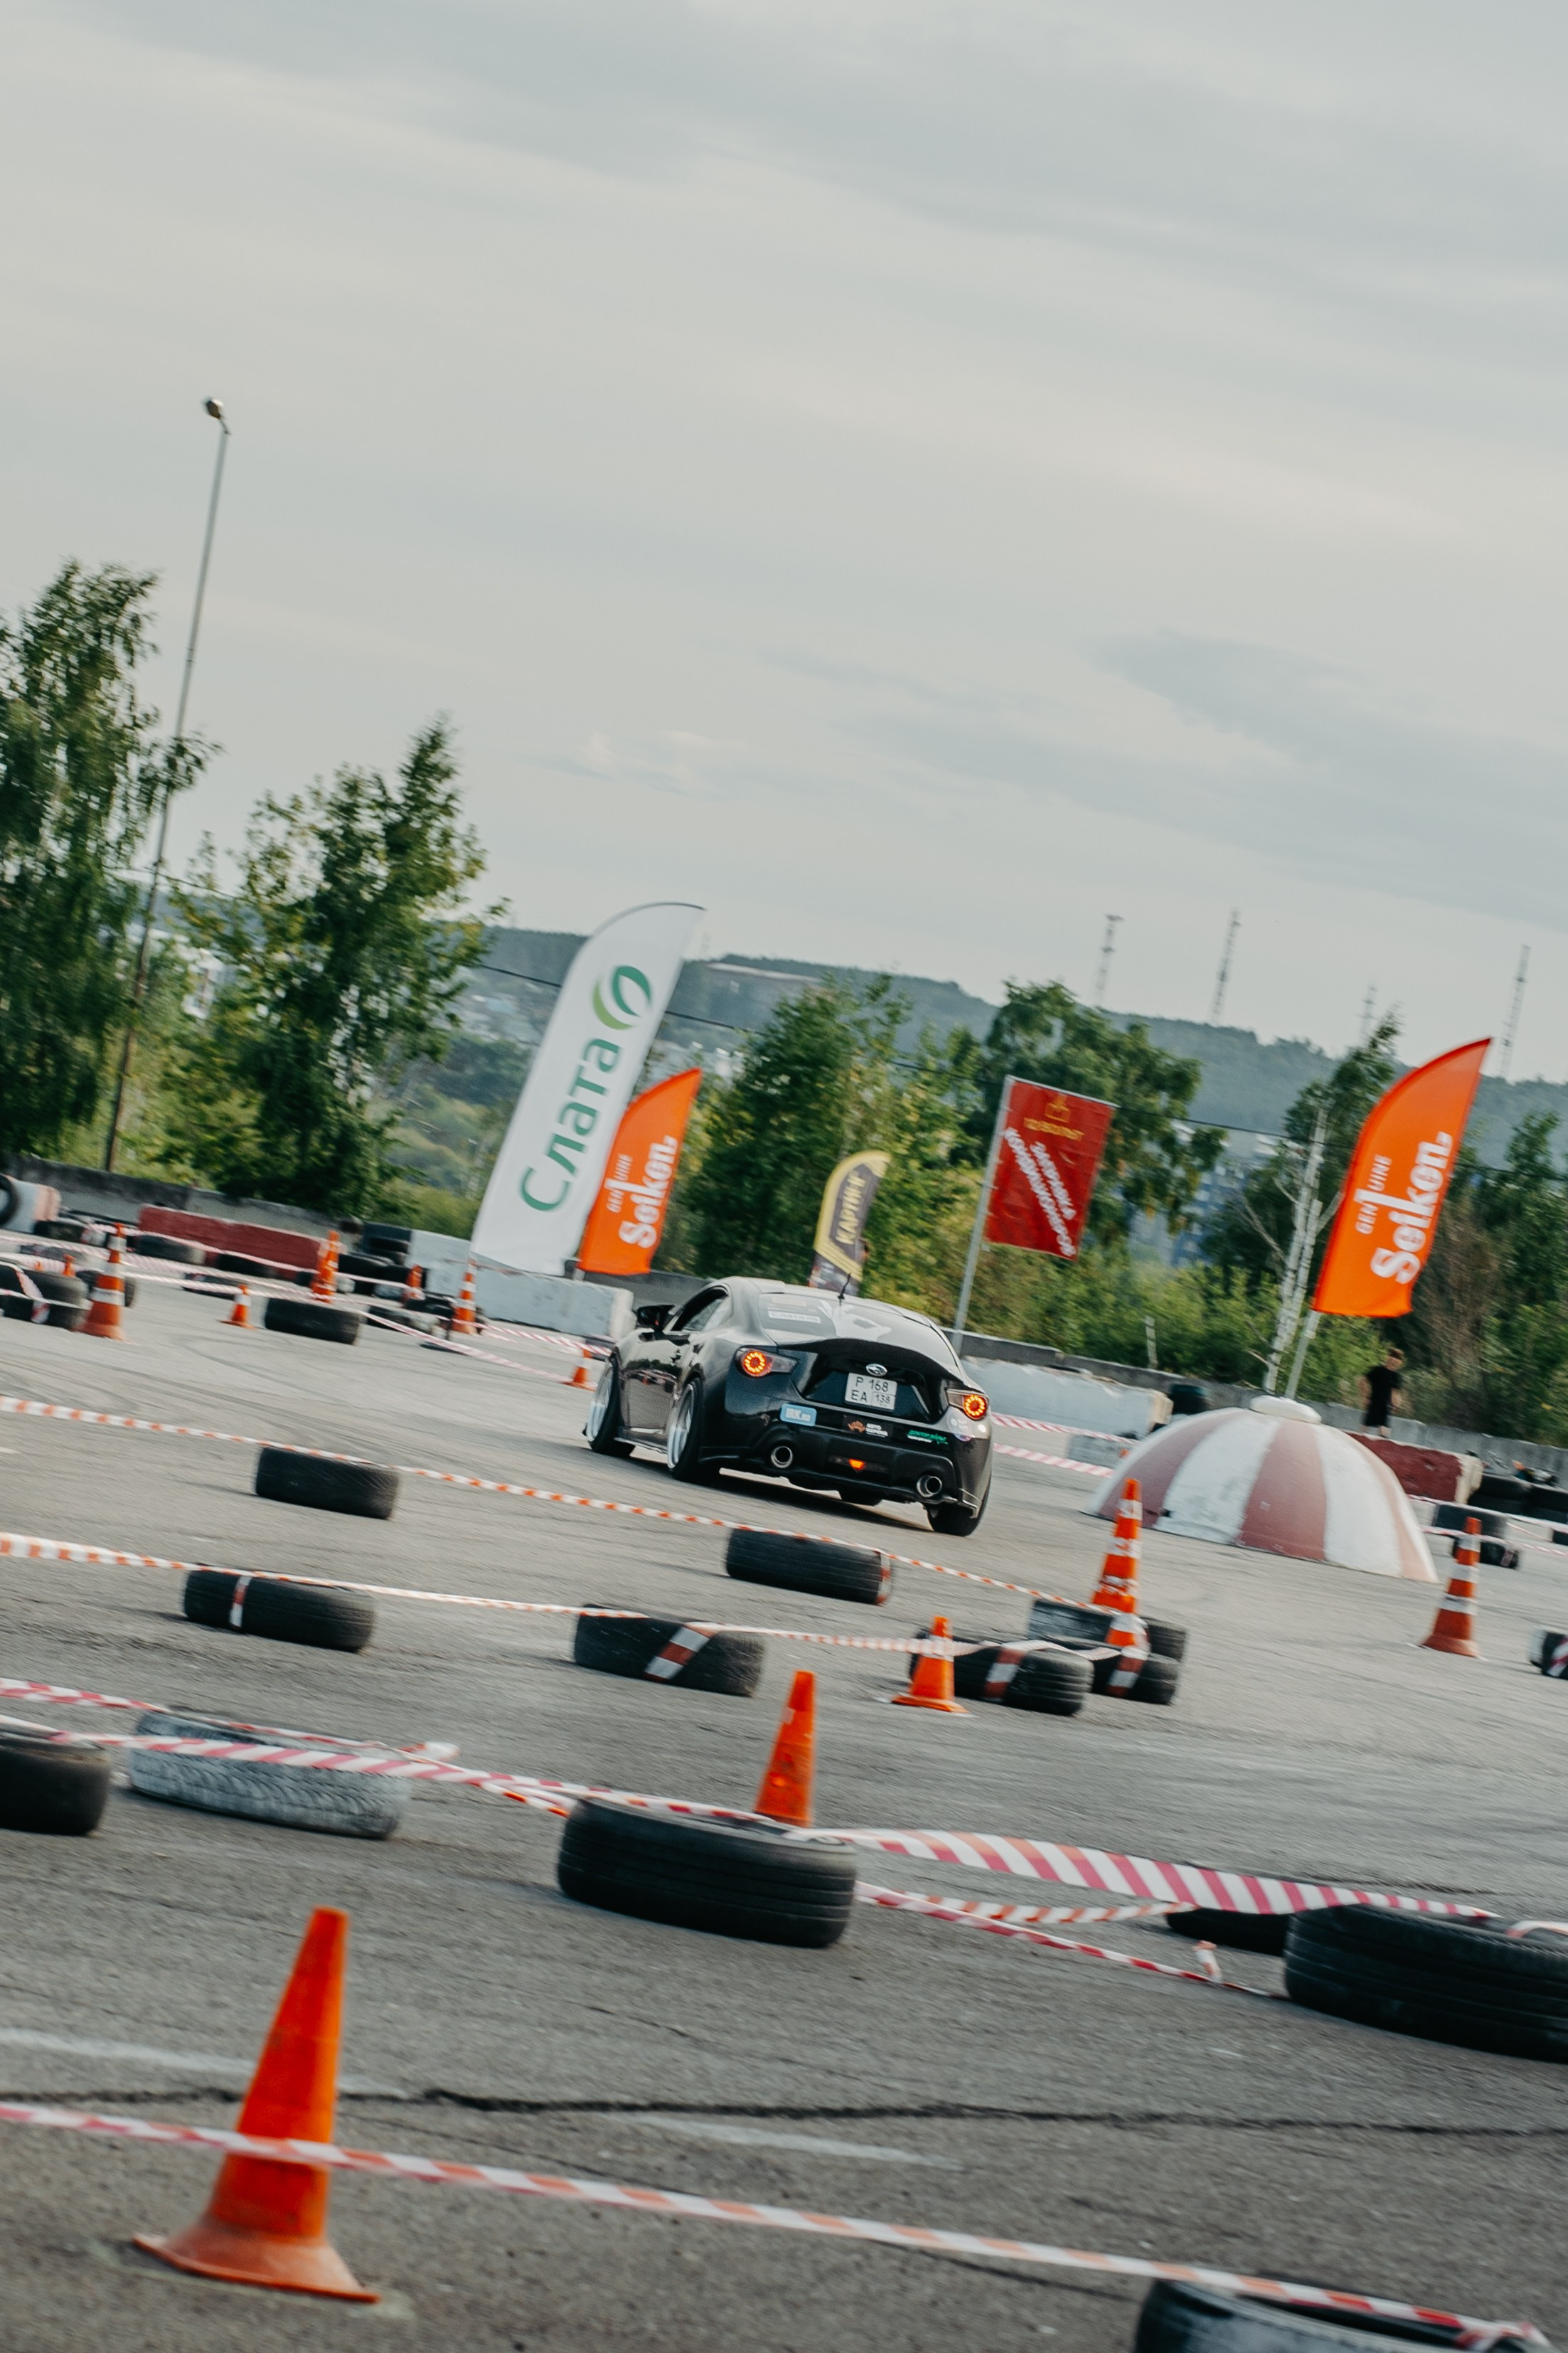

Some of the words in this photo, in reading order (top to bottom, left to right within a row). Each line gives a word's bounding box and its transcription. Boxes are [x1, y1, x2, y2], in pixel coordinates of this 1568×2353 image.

[519, 1037, 622, 1211] Слата
[1353, 1131, 1453, 1285] Seiken
[869, 1379, 889, 1392] 168
